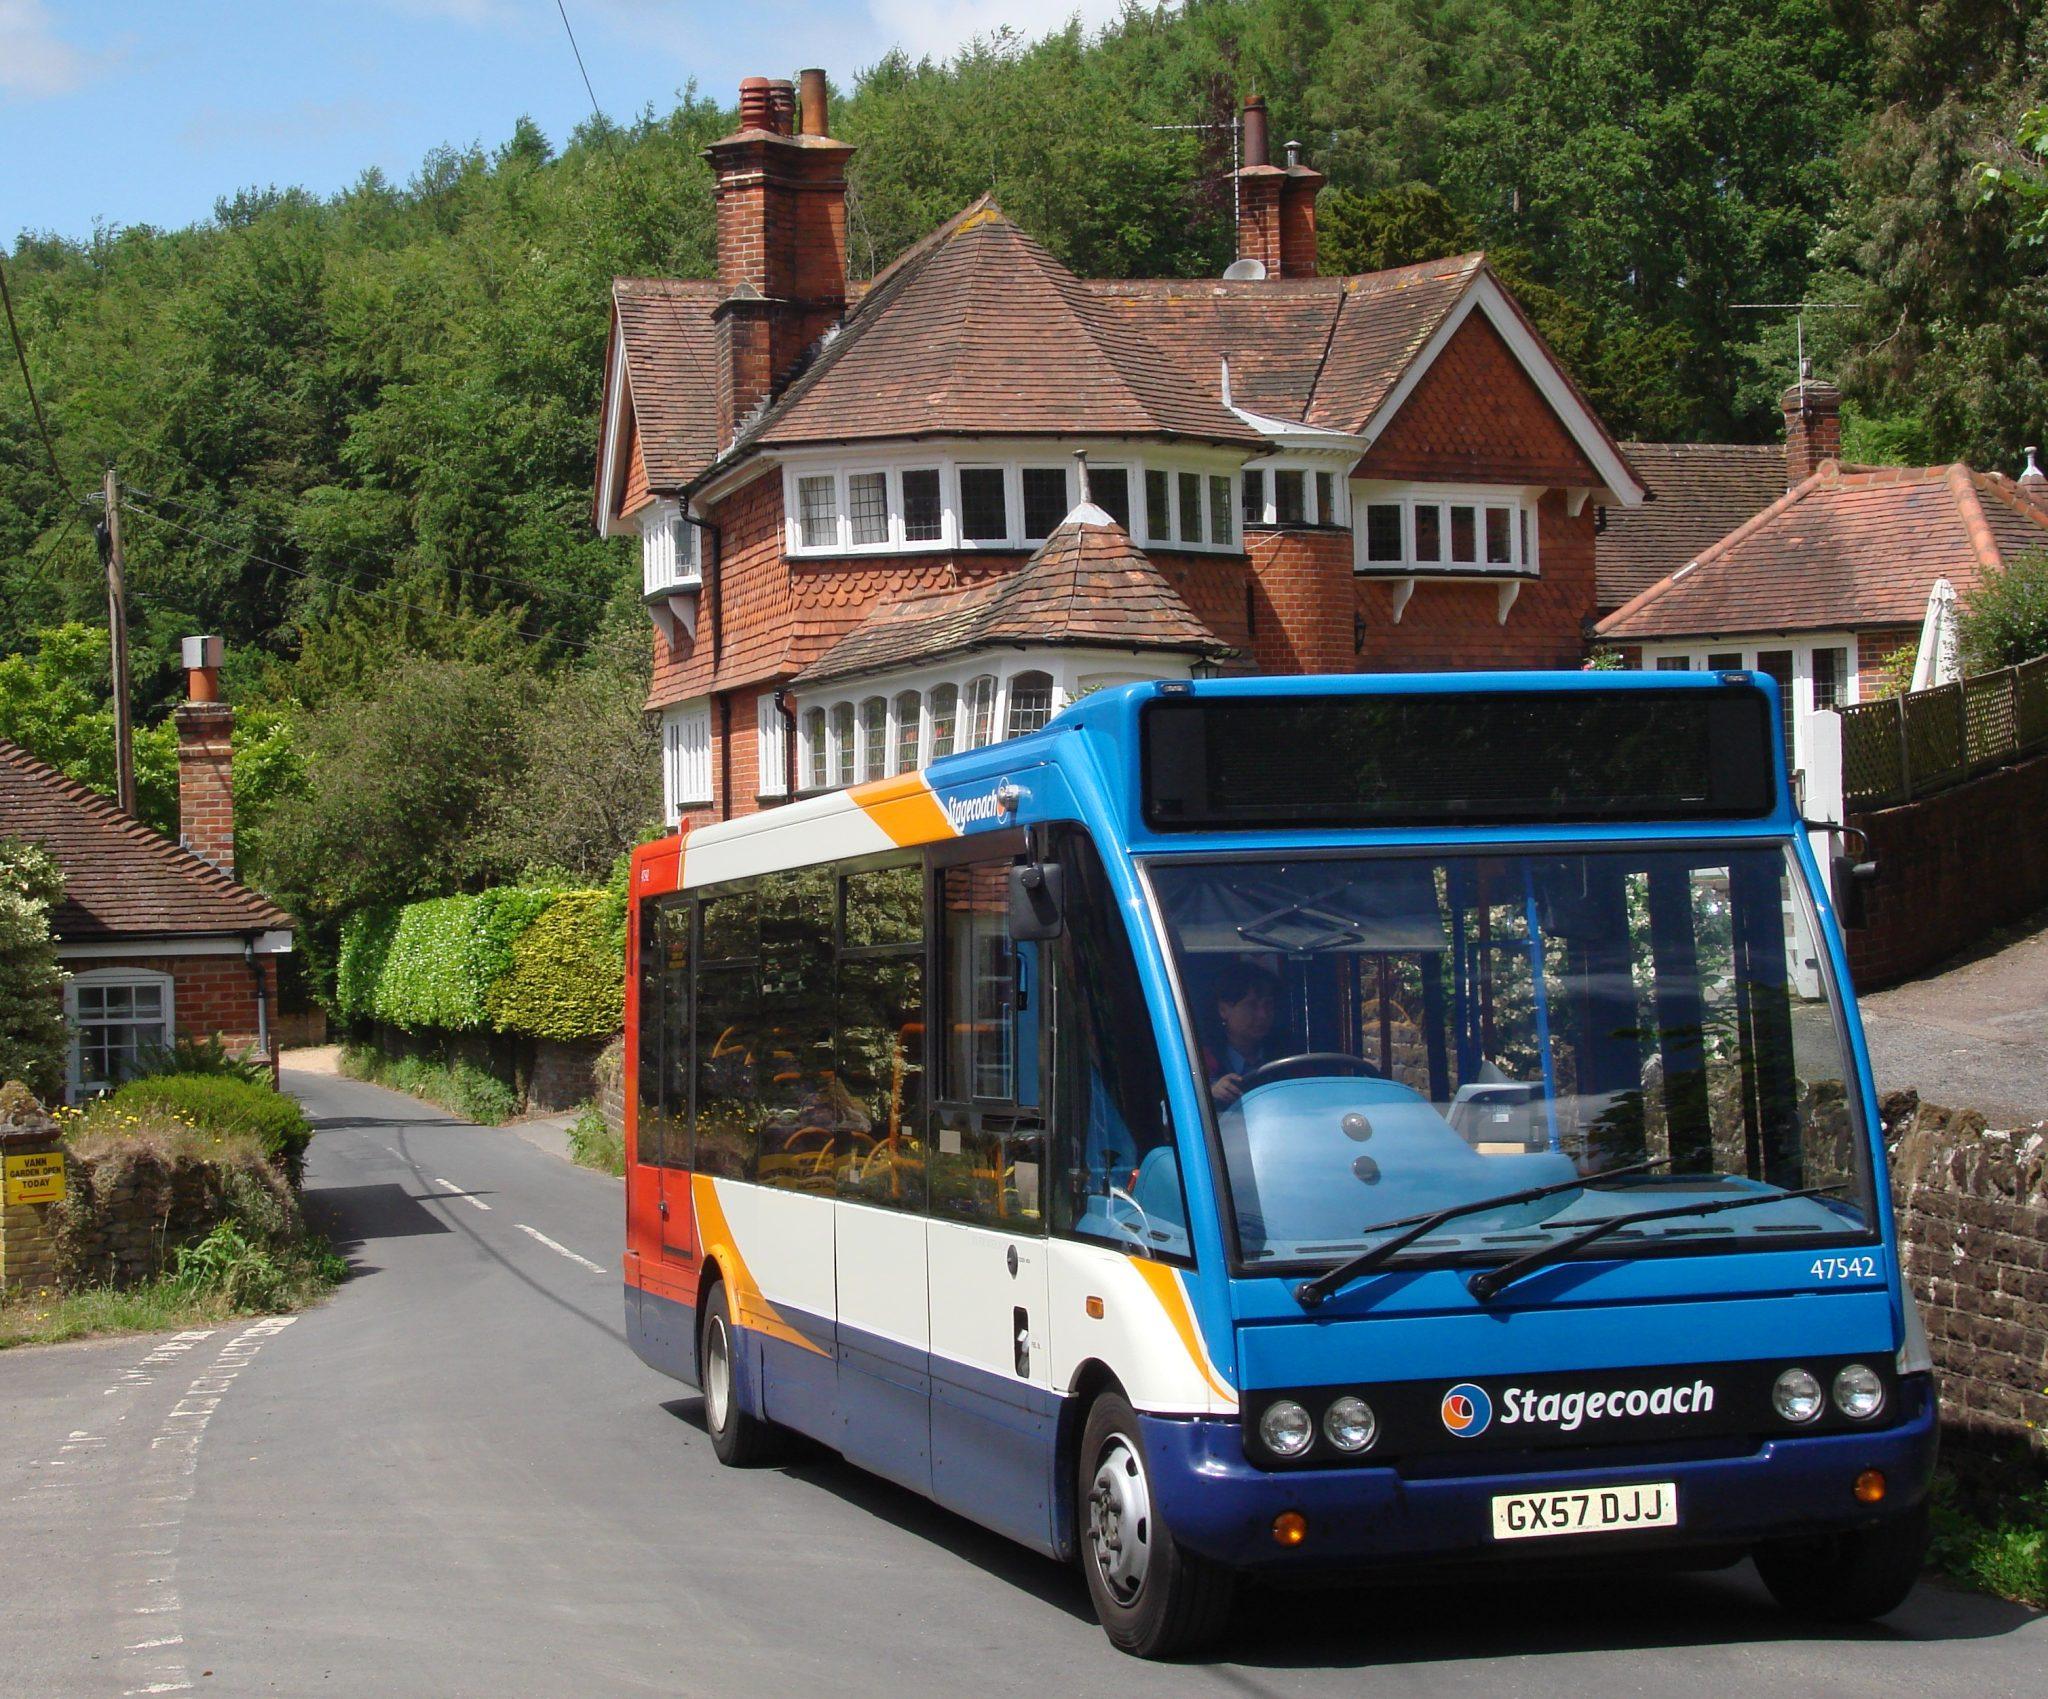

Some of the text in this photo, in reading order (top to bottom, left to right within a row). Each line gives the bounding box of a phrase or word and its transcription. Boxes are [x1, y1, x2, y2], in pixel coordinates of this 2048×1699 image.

[948, 789, 998, 832] Stagecoach
[9, 1166, 61, 1178] GARDEN OPEN
[24, 1157, 47, 1168] VANN
[22, 1178, 50, 1189] TODAY
[1810, 1256, 1877, 1280] 47542
[1500, 1379, 1714, 1431] Stagecoach
[1507, 1489, 1661, 1531] GX57 DJJ
